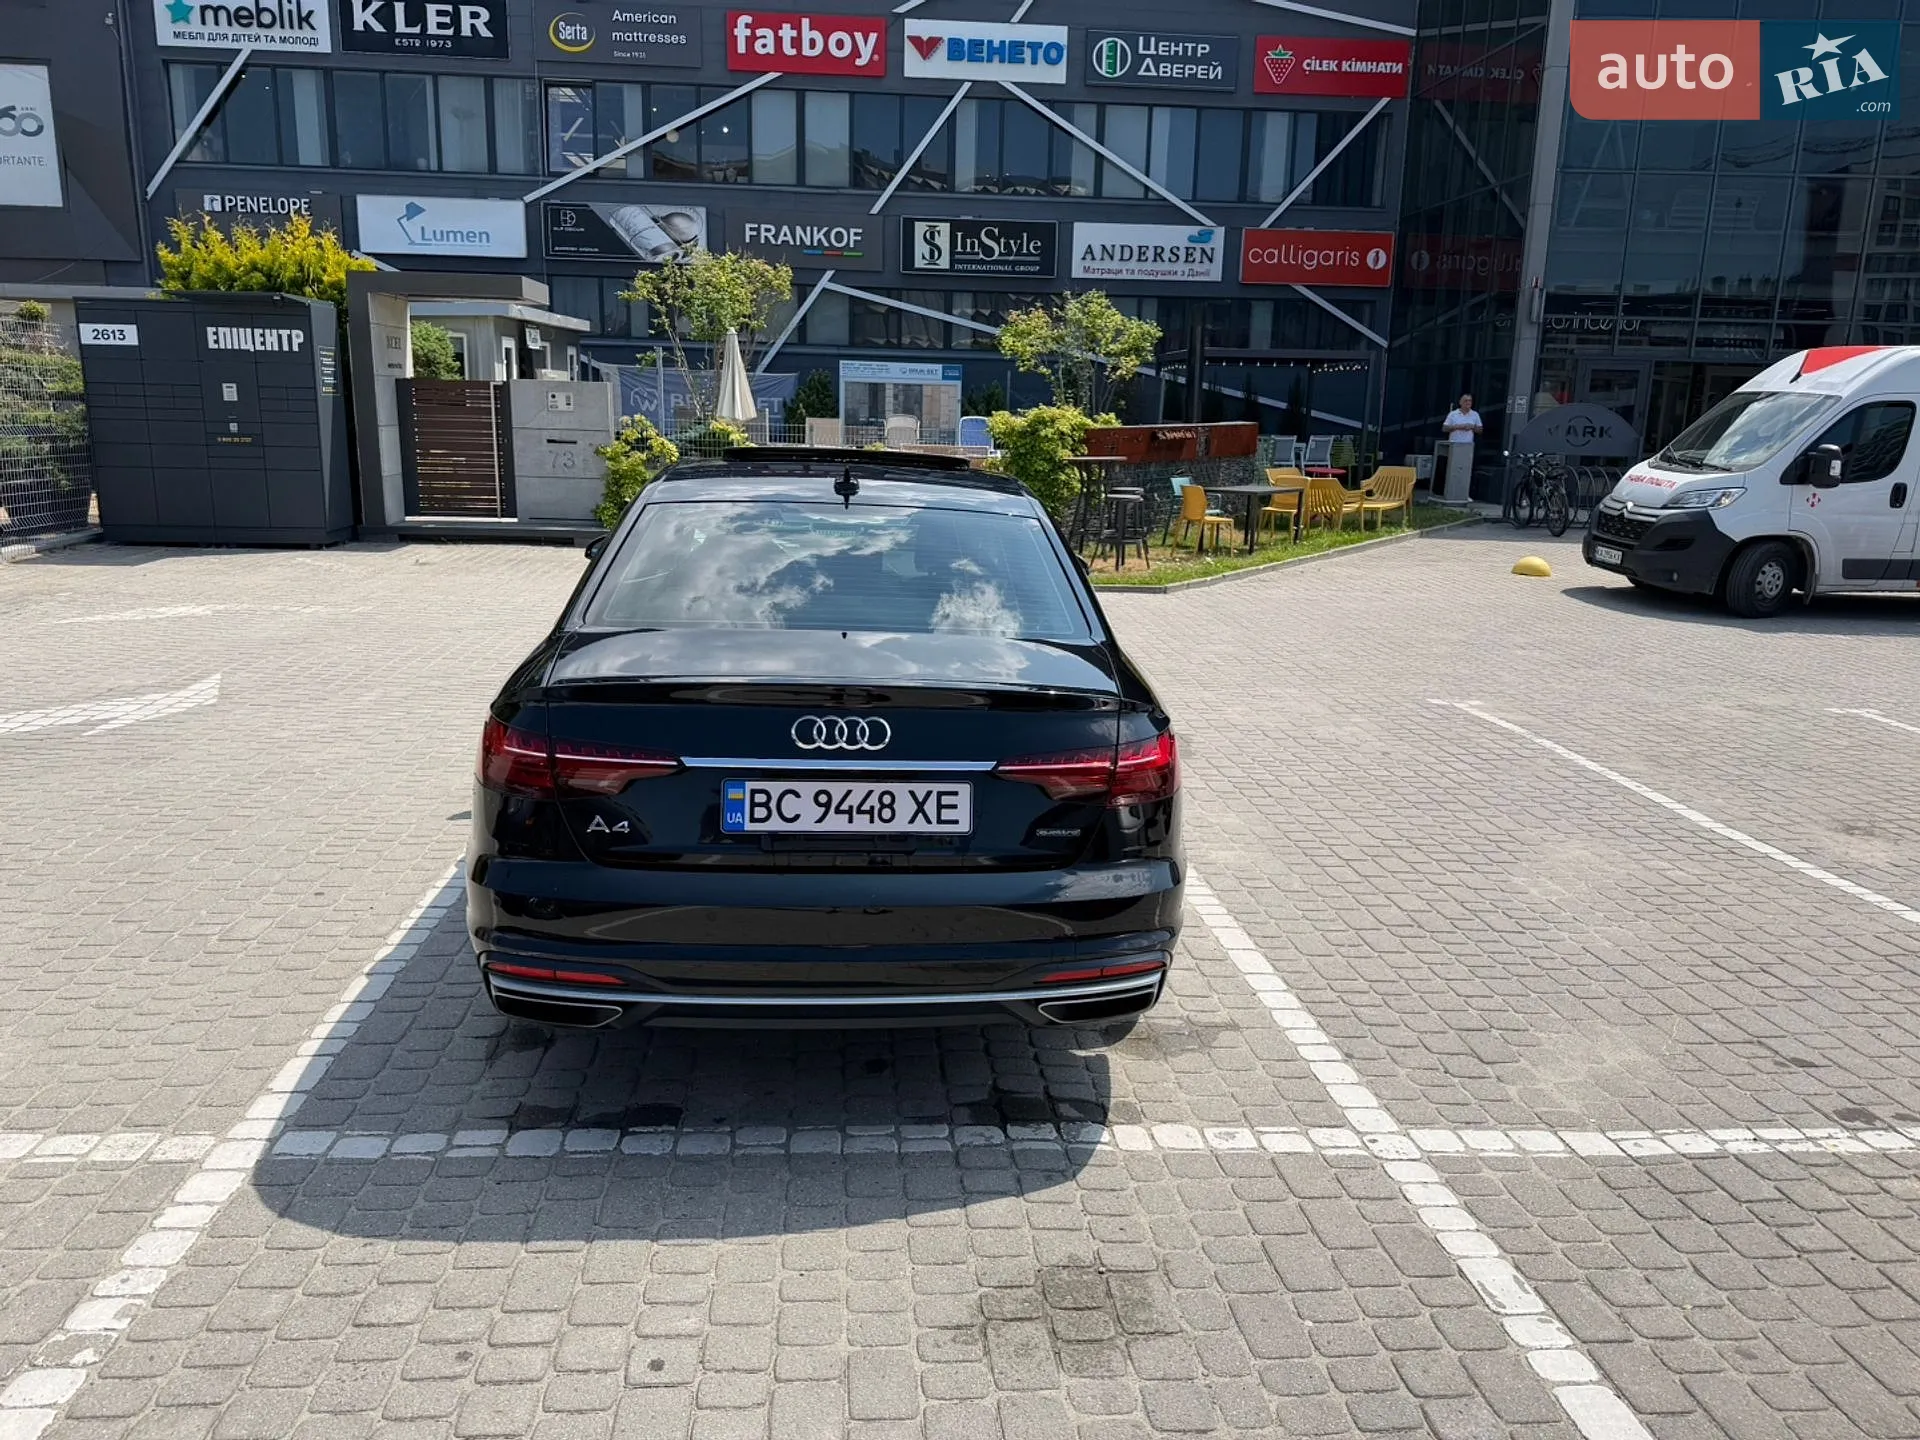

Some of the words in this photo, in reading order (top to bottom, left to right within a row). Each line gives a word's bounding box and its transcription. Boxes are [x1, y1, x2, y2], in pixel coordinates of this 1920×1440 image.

[200, 0, 317, 31] meblik
[352, 0, 495, 38] KLER
[612, 10, 677, 24] American
[173, 31, 206, 41] МЕБЛІ
[207, 32, 229, 43] ДЛЯ
[231, 32, 262, 44] ДІТЕЙ
[263, 35, 277, 45] ТА
[278, 36, 320, 48] МОЛОДІ
[558, 21, 588, 41] Serta
[611, 31, 688, 45] mattresses
[733, 14, 878, 67] fatboy
[425, 39, 453, 48] 1973
[946, 37, 1065, 66] ВЕНЕТО
[224, 195, 311, 215] PENELOPE
[420, 226, 491, 244] Lumen
[744, 222, 863, 248] FRANKOF
[955, 226, 1042, 261] InStyle
[1081, 244, 1216, 264] ANDERSEN
[1248, 244, 1361, 270] calligaris
[954, 263, 1013, 272] INTERNATIONAL
[1082, 265, 1123, 276] Матраци
[1124, 268, 1136, 276] та
[1137, 268, 1178, 278] подушки
[1180, 269, 1186, 277] з
[92, 328, 126, 341] 2613
[206, 326, 304, 352] ЕПІЦЕНТР
[749, 788, 802, 824] BC
[813, 789, 897, 824] 9448
[907, 790, 960, 825] XE
[586, 814, 630, 834] A4
[726, 812, 744, 824] UA
